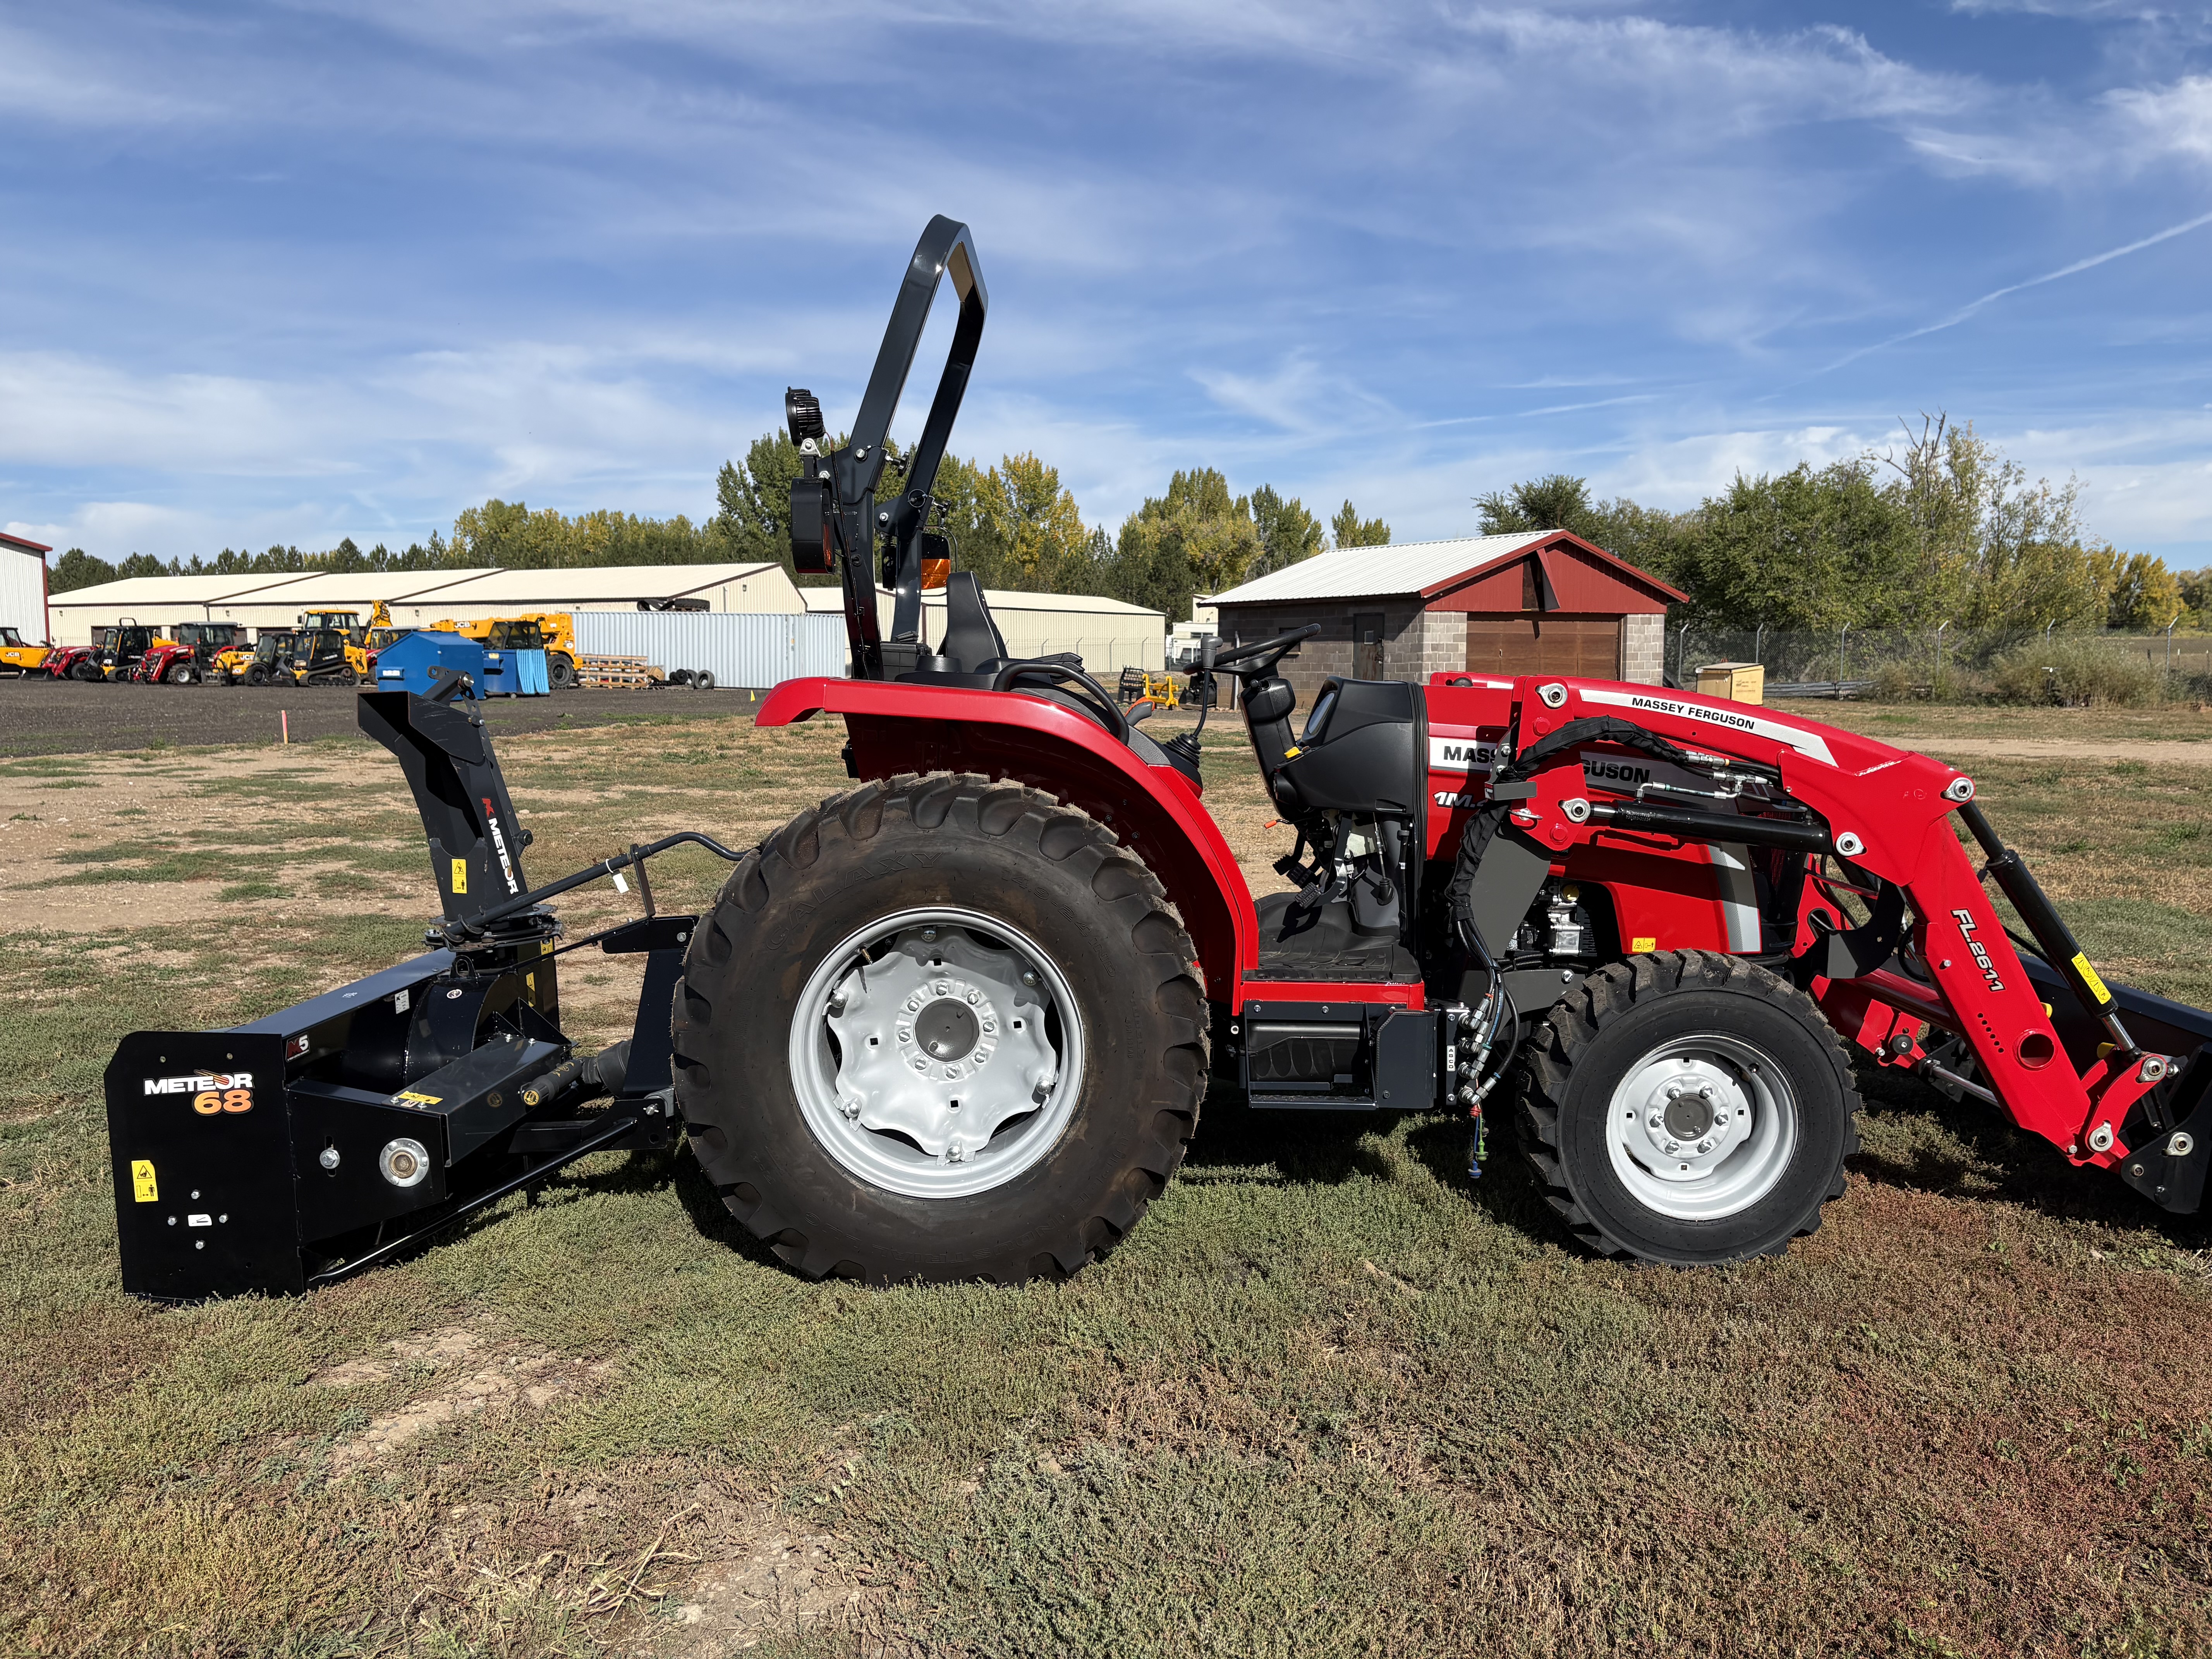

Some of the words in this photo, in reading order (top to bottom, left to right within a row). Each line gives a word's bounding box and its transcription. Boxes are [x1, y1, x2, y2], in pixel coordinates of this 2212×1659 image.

[1632, 697, 1685, 713] MASSEY
[1688, 707, 1755, 730] FERGUSON
[488, 817, 519, 895] METEOR
[765, 852, 943, 951] GALAXY
[1951, 909, 2005, 991] FL.2611
[144, 1073, 253, 1095] METEOR
[194, 1089, 252, 1114] 68
